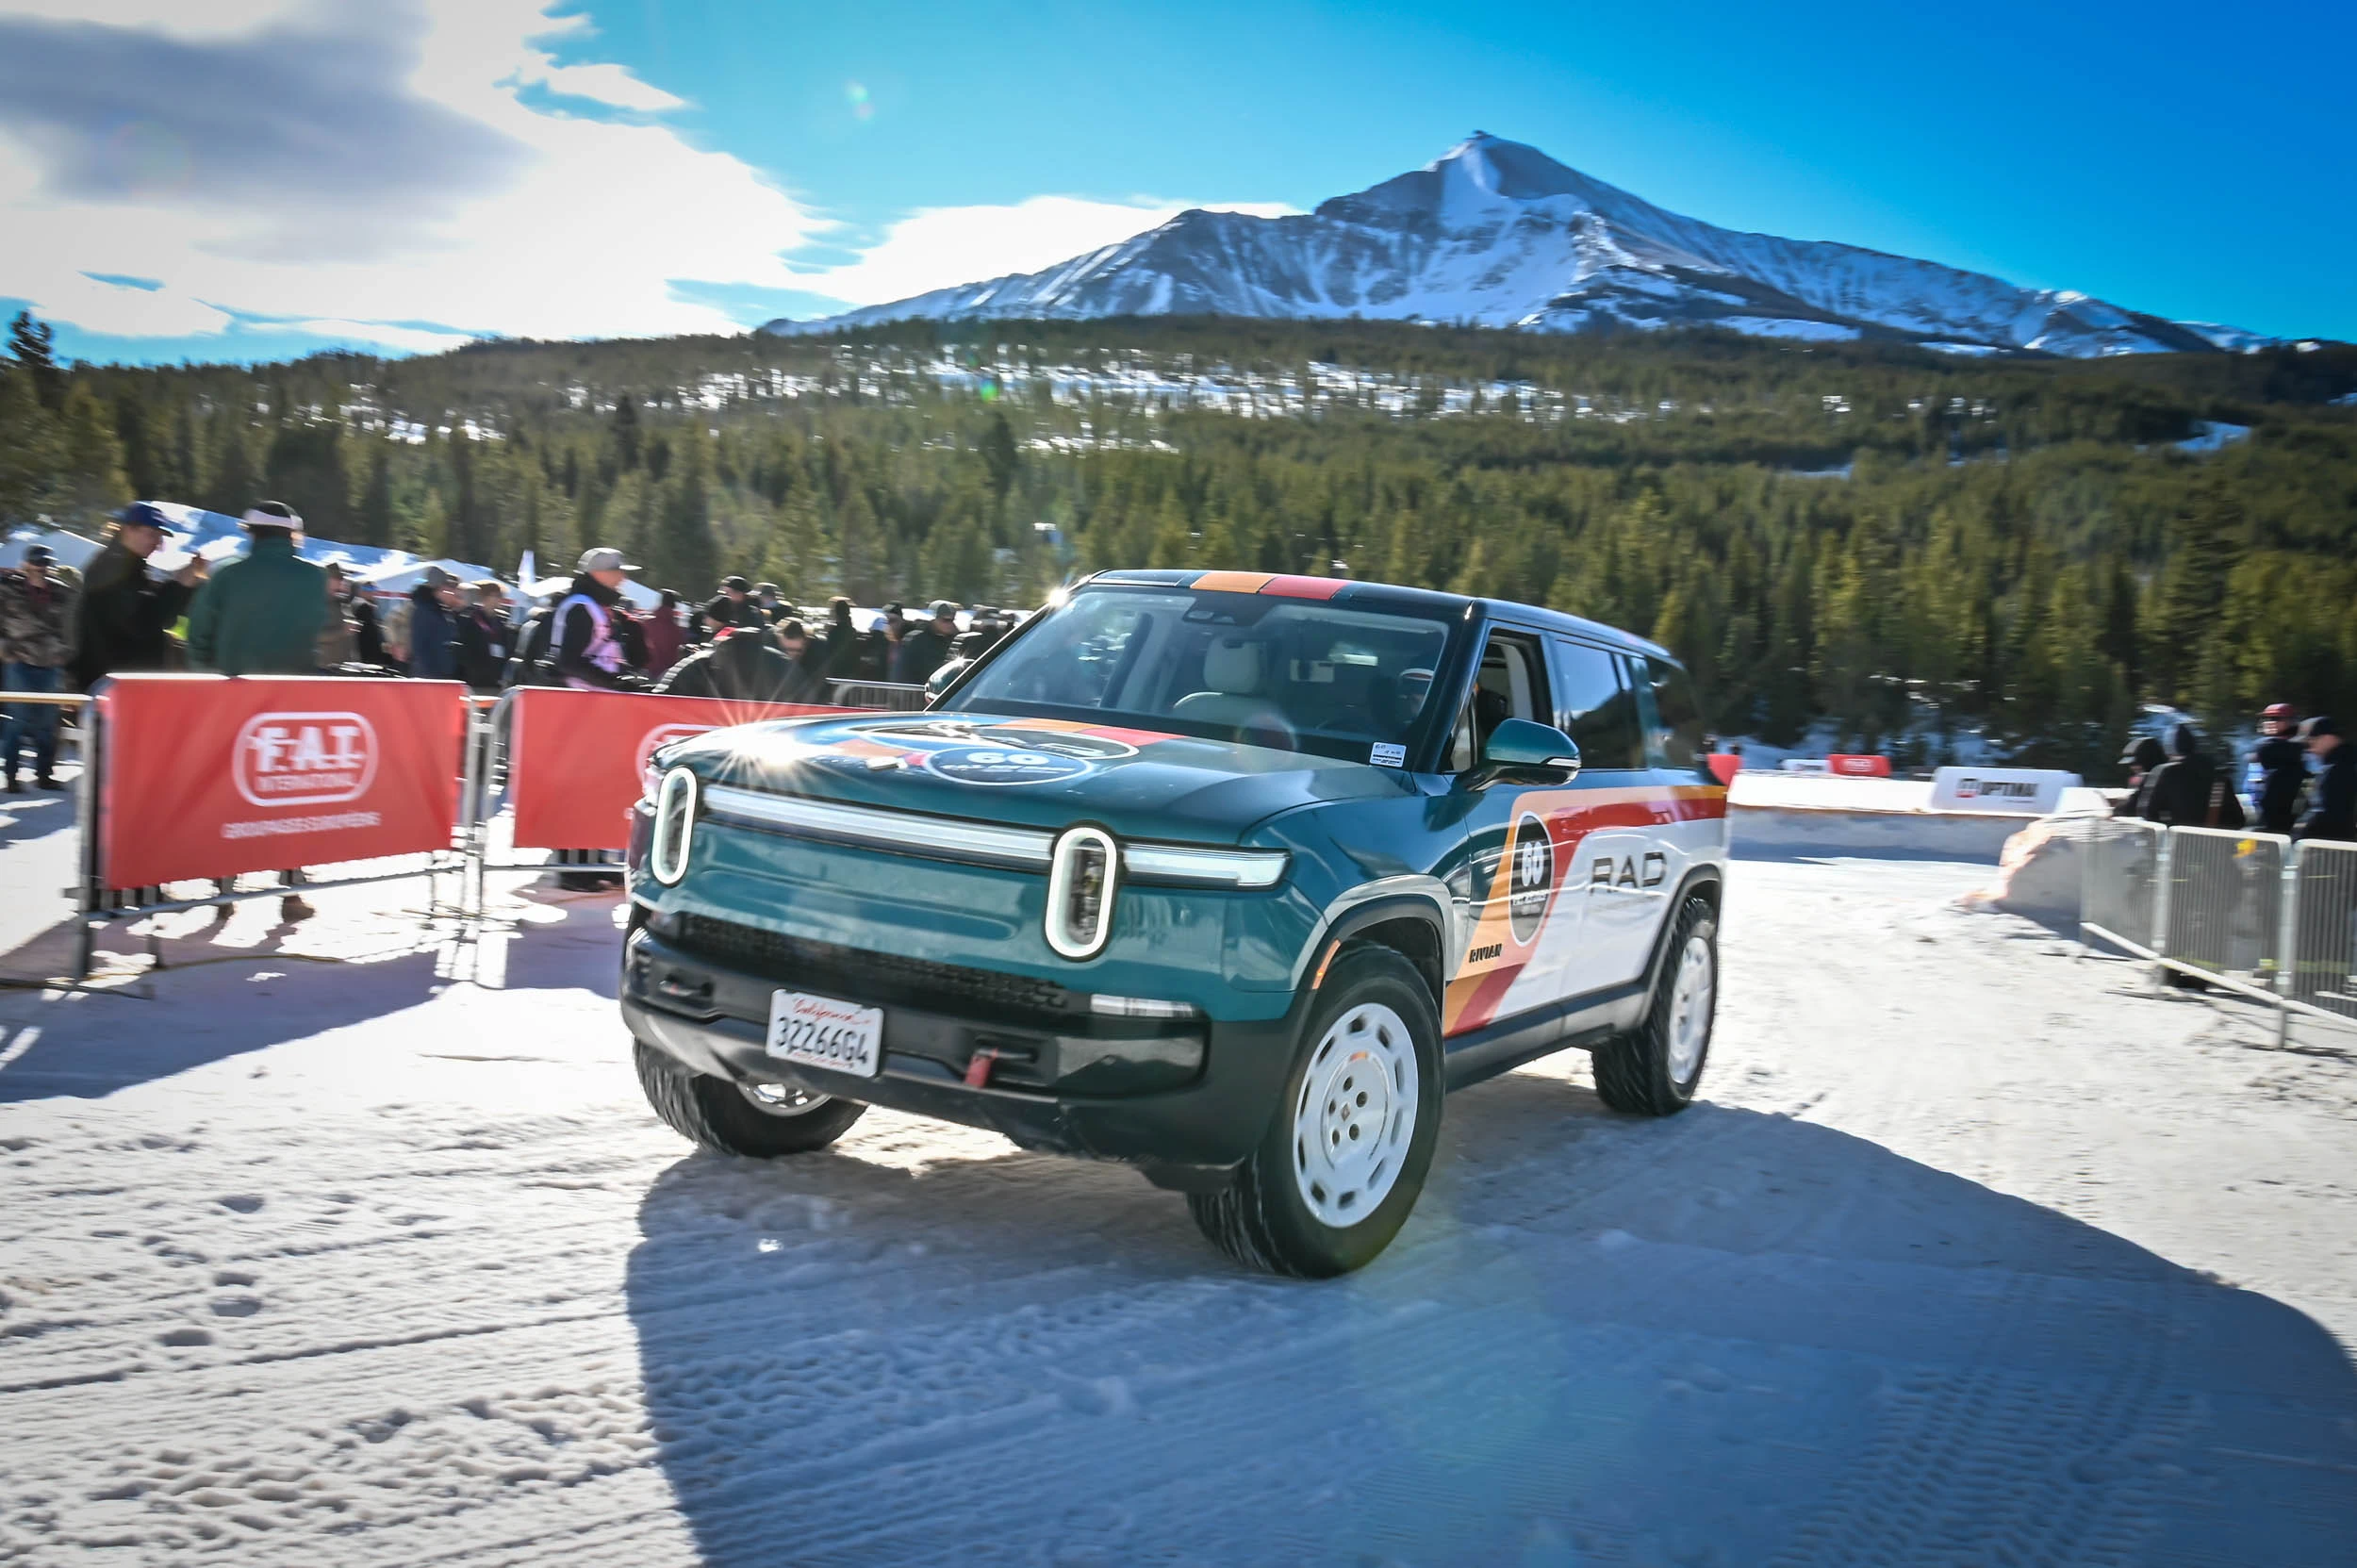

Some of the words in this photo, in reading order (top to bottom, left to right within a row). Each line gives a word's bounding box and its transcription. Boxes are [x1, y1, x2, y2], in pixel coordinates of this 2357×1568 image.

[1590, 851, 1667, 897] RAD
[1469, 943, 1503, 963] RIVIAN
[776, 1015, 869, 1065] 32266G4
